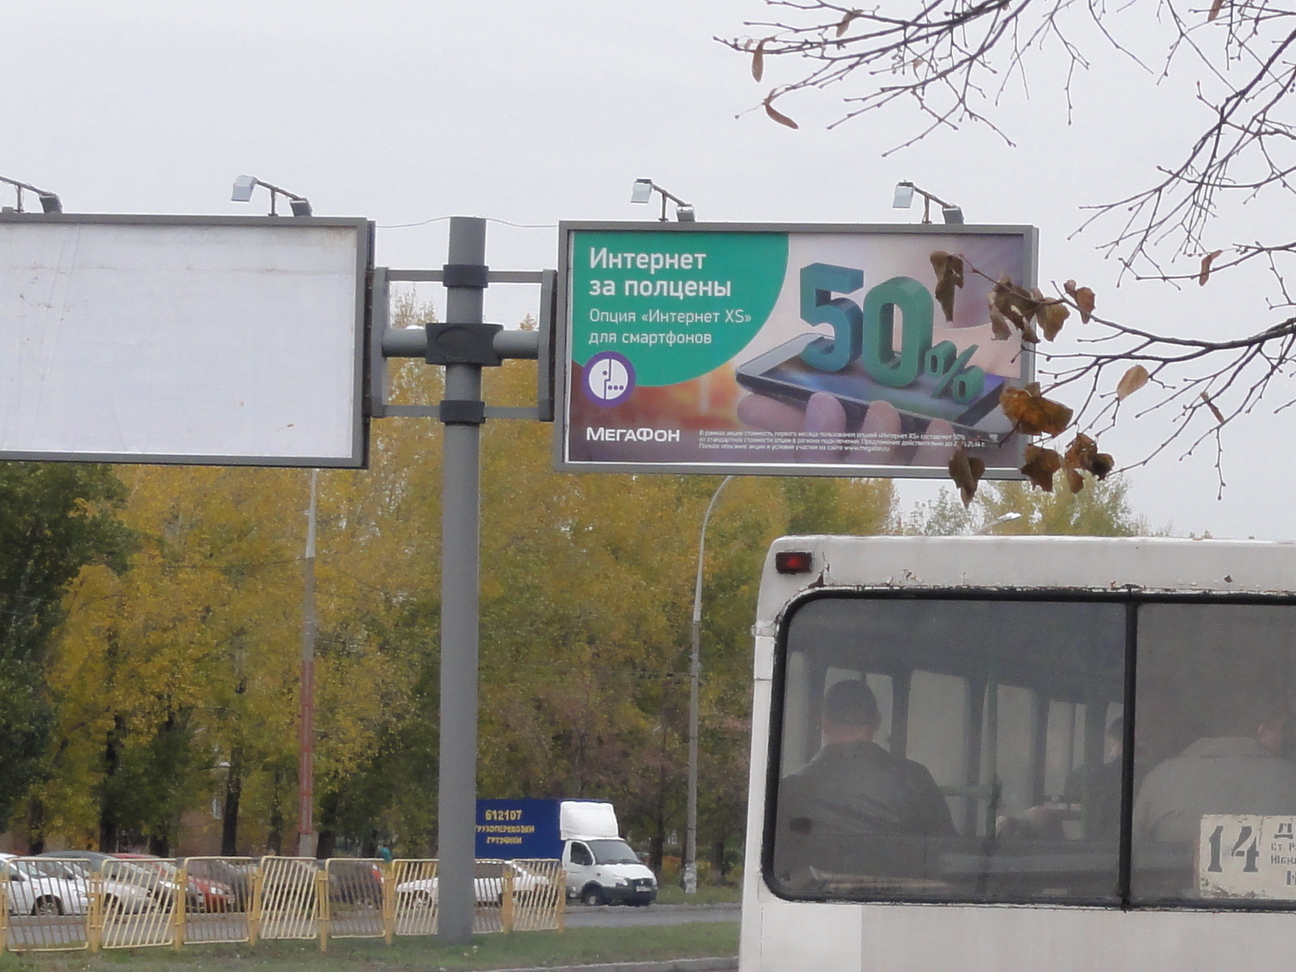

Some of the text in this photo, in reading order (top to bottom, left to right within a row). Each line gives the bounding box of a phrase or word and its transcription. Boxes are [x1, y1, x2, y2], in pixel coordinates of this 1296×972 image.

[589, 247, 706, 274] Интернет
[589, 280, 732, 300] за полцены
[589, 308, 636, 324] Опция
[641, 308, 720, 326] «Интернет
[588, 330, 712, 347] для смартфонов
[800, 262, 985, 400] 50%
[485, 810, 522, 820] 612107
[1207, 825, 1260, 873] 14
